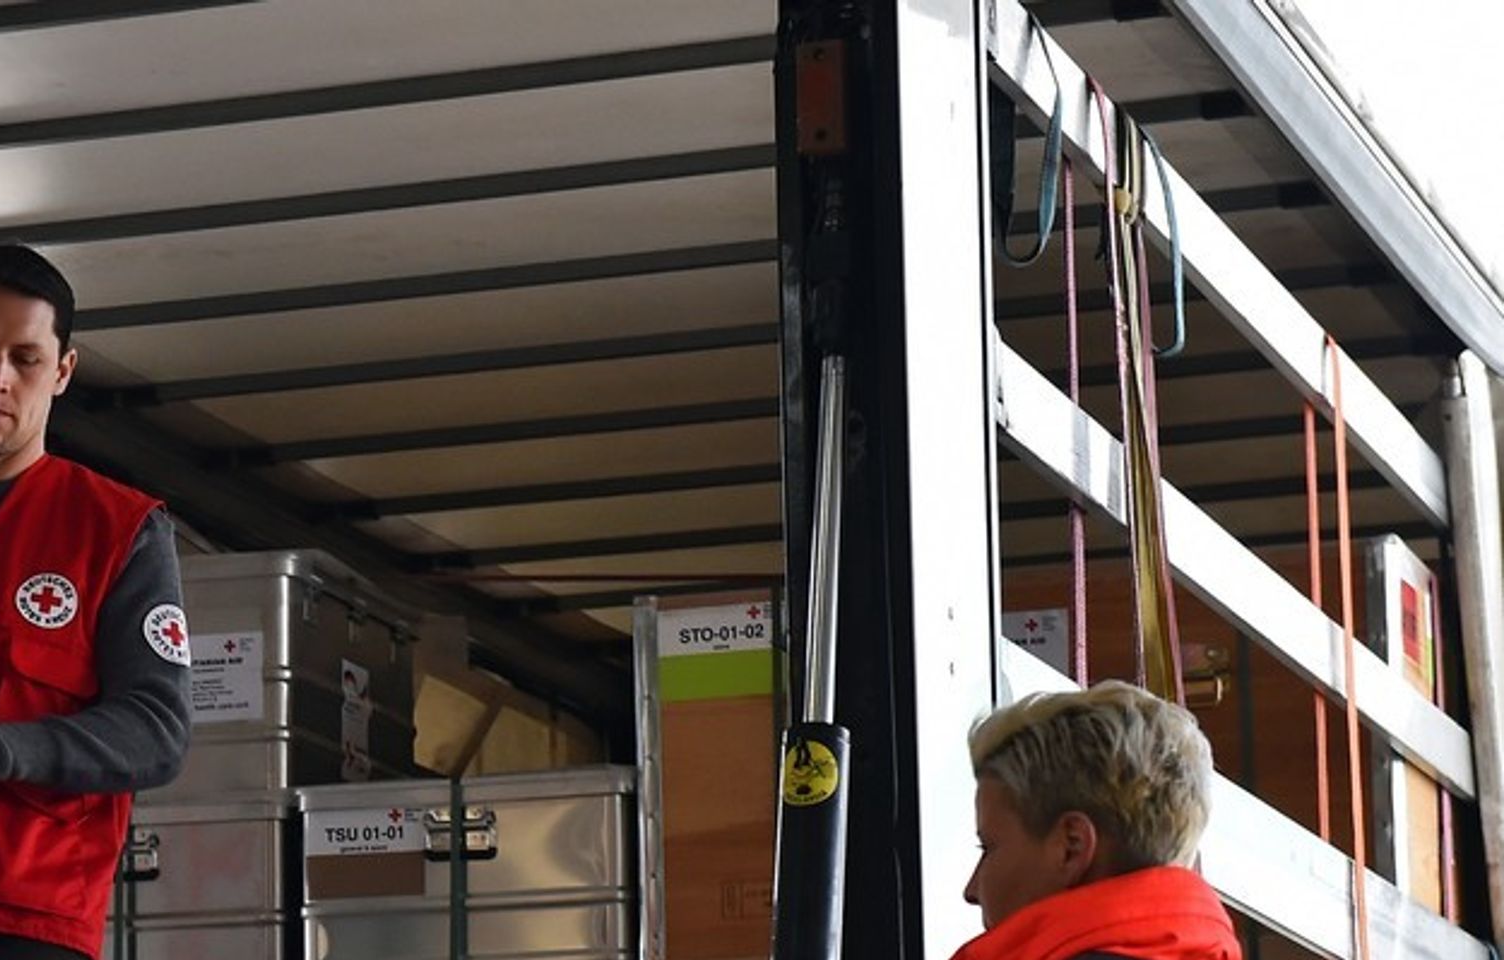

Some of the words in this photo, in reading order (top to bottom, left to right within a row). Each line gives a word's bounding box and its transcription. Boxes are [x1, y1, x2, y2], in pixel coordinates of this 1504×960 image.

[678, 623, 765, 644] STO-01-02
[325, 827, 357, 842] TSU
[362, 825, 404, 841] 01-01
